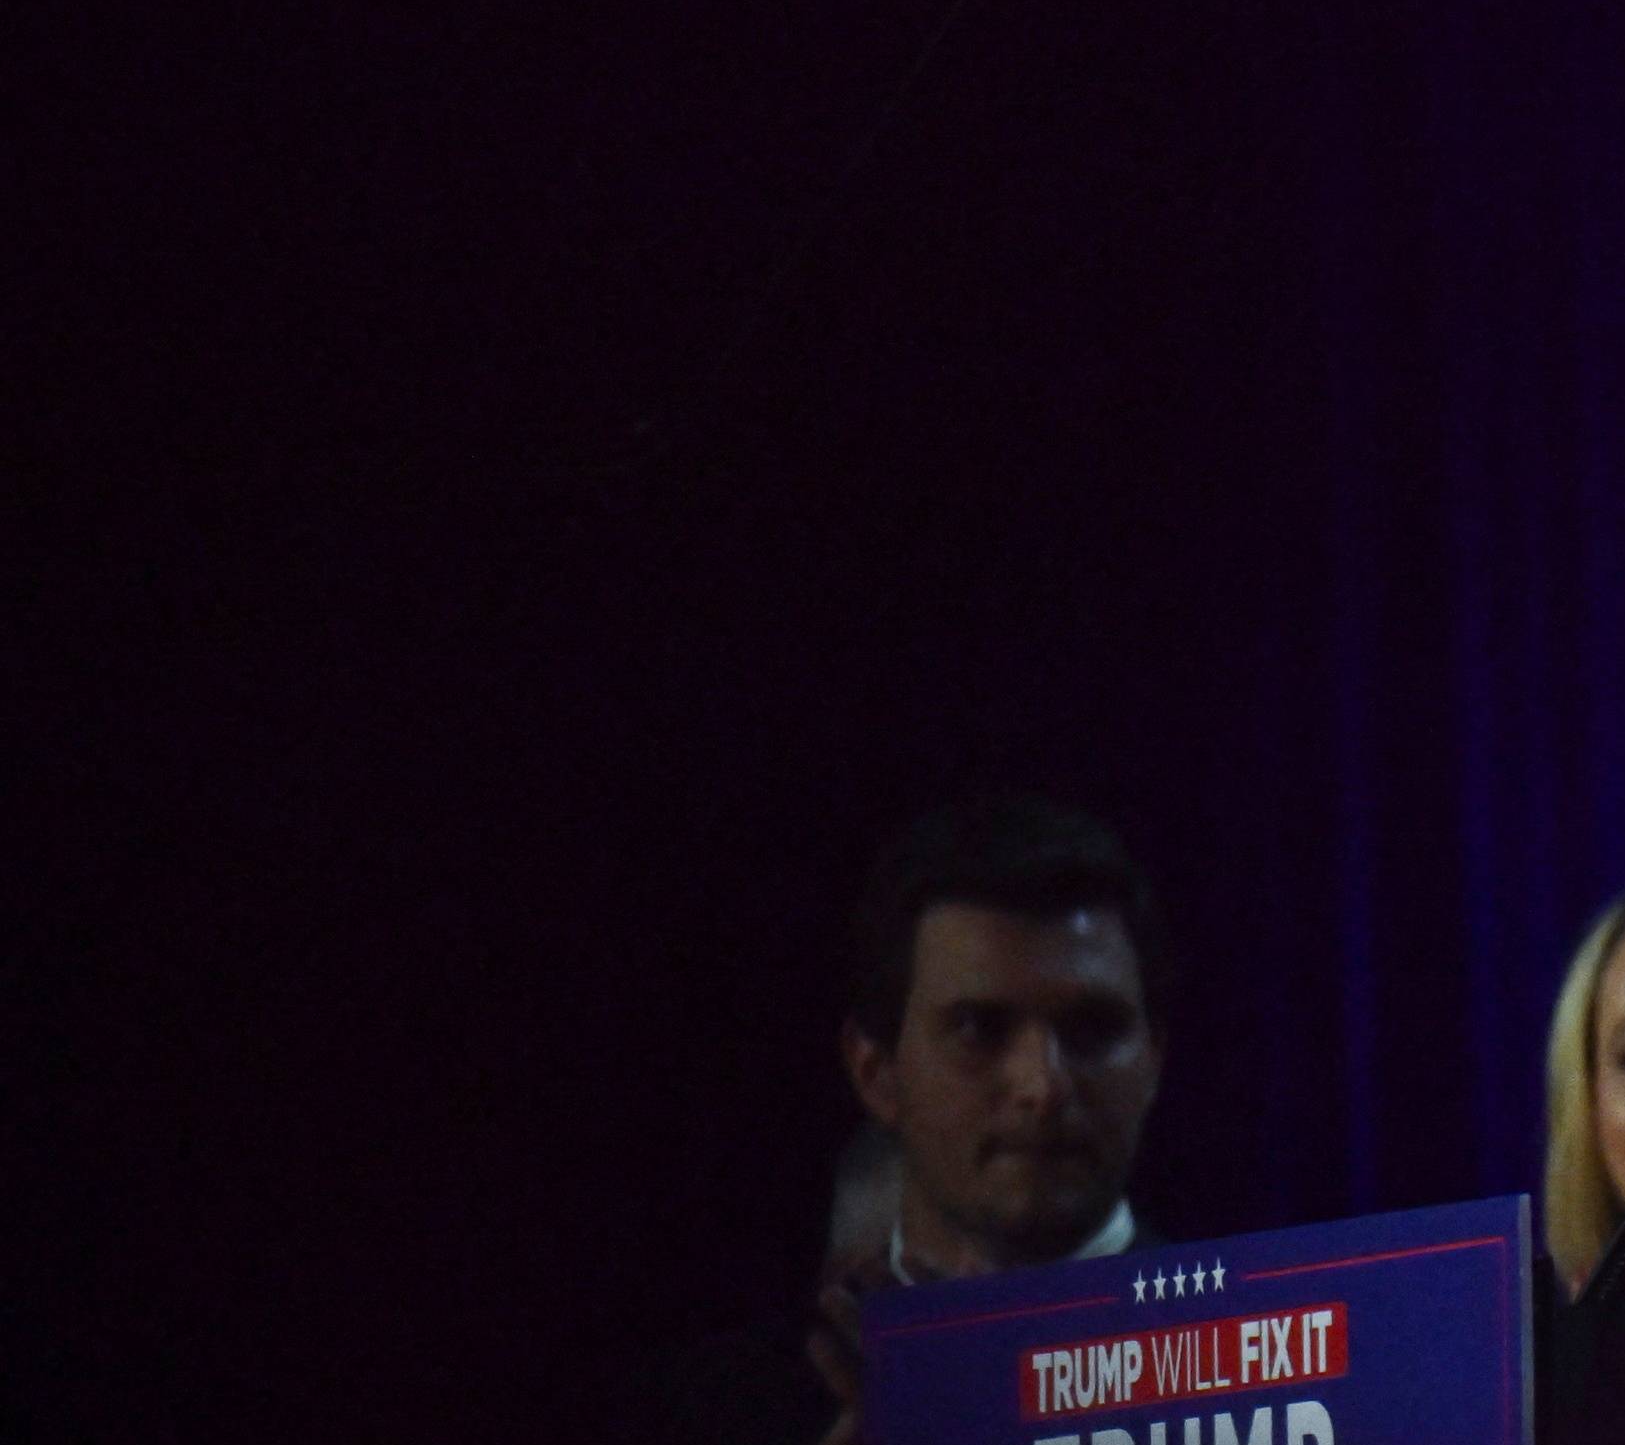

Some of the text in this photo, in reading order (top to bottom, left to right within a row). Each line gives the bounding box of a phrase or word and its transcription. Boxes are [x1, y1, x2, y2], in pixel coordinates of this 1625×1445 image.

[1033, 1310, 1333, 1413] TRUMP WILL FIX IT
